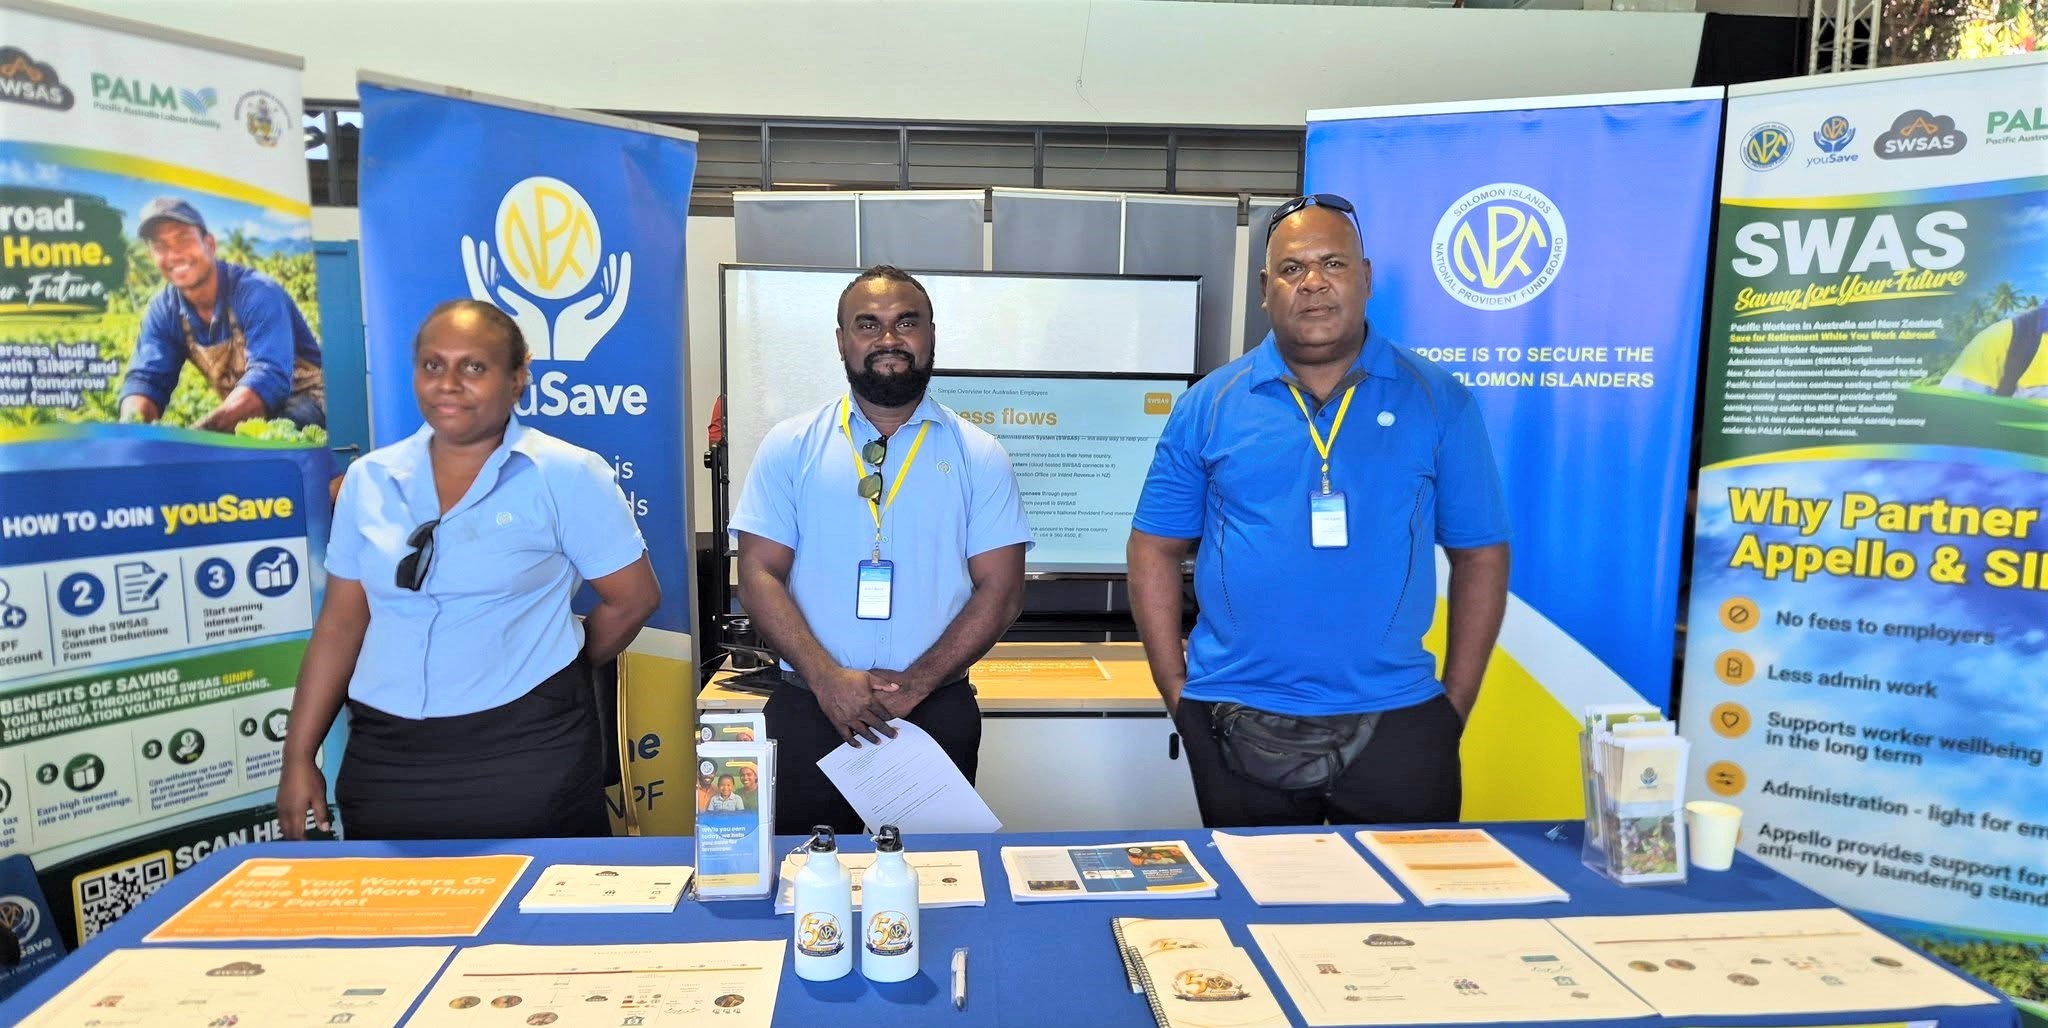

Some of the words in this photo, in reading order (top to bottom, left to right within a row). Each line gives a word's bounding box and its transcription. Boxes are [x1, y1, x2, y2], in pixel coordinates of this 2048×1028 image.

[0, 77, 62, 104] WSAS
[91, 71, 177, 111] PALM
[1884, 135, 1955, 153] SWSAS
[1806, 153, 1858, 168] youSave
[1452, 187, 1507, 218] SOLOMON
[1508, 187, 1552, 215] ISLANDS
[3, 235, 113, 269] Home.
[1731, 210, 1968, 278] SWAS
[1435, 242, 1457, 292] NATIONAL
[1457, 288, 1519, 306] PROVIDENT
[1520, 276, 1548, 299] FUND
[1546, 236, 1564, 276] BOARD
[1734, 287, 1803, 312] Saving
[1836, 273, 1896, 307] Your
[1893, 266, 1968, 293] Future
[57, 342, 97, 359] build
[1409, 347, 1467, 363] POSE
[1472, 347, 1490, 362] IS
[1495, 347, 1521, 362] TO
[1526, 347, 1608, 363] SECURE
[1614, 346, 1654, 362] THE
[36, 359, 85, 374] SINPF
[88, 359, 118, 374] and
[1540, 371, 1654, 388] ISLANDERS
[31, 375, 106, 391] tomorrow
[937, 387, 957, 396] Simple
[958, 388, 982, 396] Overview
[957, 410, 996, 425] ess
[1002, 407, 1057, 426] flows
[2, 514, 58, 539] HOW
[63, 511, 97, 533] TO
[101, 506, 154, 530] JOIN
[161, 494, 293, 536] youSave
[1728, 487, 1832, 536] Why
[1841, 491, 2039, 538] Partner
[1729, 533, 1917, 582] Appello
[1929, 546, 1967, 584] &
[1983, 548, 2048, 590] SI
[207, 565, 227, 590] 3
[71, 579, 94, 608] 2
[203, 607, 225, 618] Start
[203, 615, 238, 628] interest
[241, 614, 253, 622] on
[61, 627, 86, 640] Sign
[89, 623, 106, 634] the
[108, 617, 149, 631] SWSAS
[62, 637, 107, 650] Consent
[110, 626, 169, 642] Deductions
[205, 629, 225, 641] your
[1776, 610, 1804, 627] No
[1808, 612, 1851, 633] fees
[1857, 617, 1879, 635] to
[1883, 620, 1996, 647] employers
[63, 650, 92, 662] Form
[0, 685, 86, 716] BENEFITS
[89, 680, 113, 698] OF
[115, 668, 179, 693] SAVING
[1767, 665, 1813, 685] Less
[1818, 669, 1881, 692] admin
[1887, 677, 1938, 700] work
[1, 711, 39, 730] YOUR
[41, 701, 88, 721] MONEY
[90, 690, 151, 711] THROUGH
[153, 685, 178, 698] THE
[179, 676, 220, 693] SWSAS
[3, 707, 123, 743] SUPERANNUATION
[125, 692, 197, 718] VOLUNTARY
[199, 677, 271, 701] DEDUCTIONS.
[1766, 729, 1783, 747] in
[1788, 734, 1820, 752] the
[1825, 737, 1869, 762] long
[1874, 746, 1923, 767] term
[1767, 711, 1857, 738] Supports
[1862, 727, 1936, 750] worker
[1941, 735, 2043, 767] wellbeing
[37, 806, 58, 817] Earn
[60, 798, 80, 811] high
[82, 790, 118, 803] interest
[38, 817, 57, 827] rate
[58, 813, 70, 821] on
[72, 807, 93, 819] your
[1761, 779, 1909, 817] Administration
[1928, 803, 1976, 828] light
[1981, 811, 2013, 832] for
[3, 827, 15, 836] on
[175, 828, 247, 871] SCAN
[253, 808, 317, 844] HEE
[1758, 823, 1833, 849] Appello
[1837, 838, 1924, 865] provides
[1928, 854, 2012, 881] support
[2018, 866, 2048, 888] for
[234, 878, 291, 889] Help
[300, 877, 355, 888] Your
[360, 876, 456, 887] Workers
[464, 876, 497, 886] Go
[1757, 842, 1869, 878] anti-money
[1873, 860, 1984, 900] laundering
[221, 888, 294, 898] Home
[301, 887, 355, 897] With
[361, 887, 421, 897] More
[430, 886, 487, 896] Than
[230, 898, 278, 910] Pay
[283, 897, 369, 908] Packet
